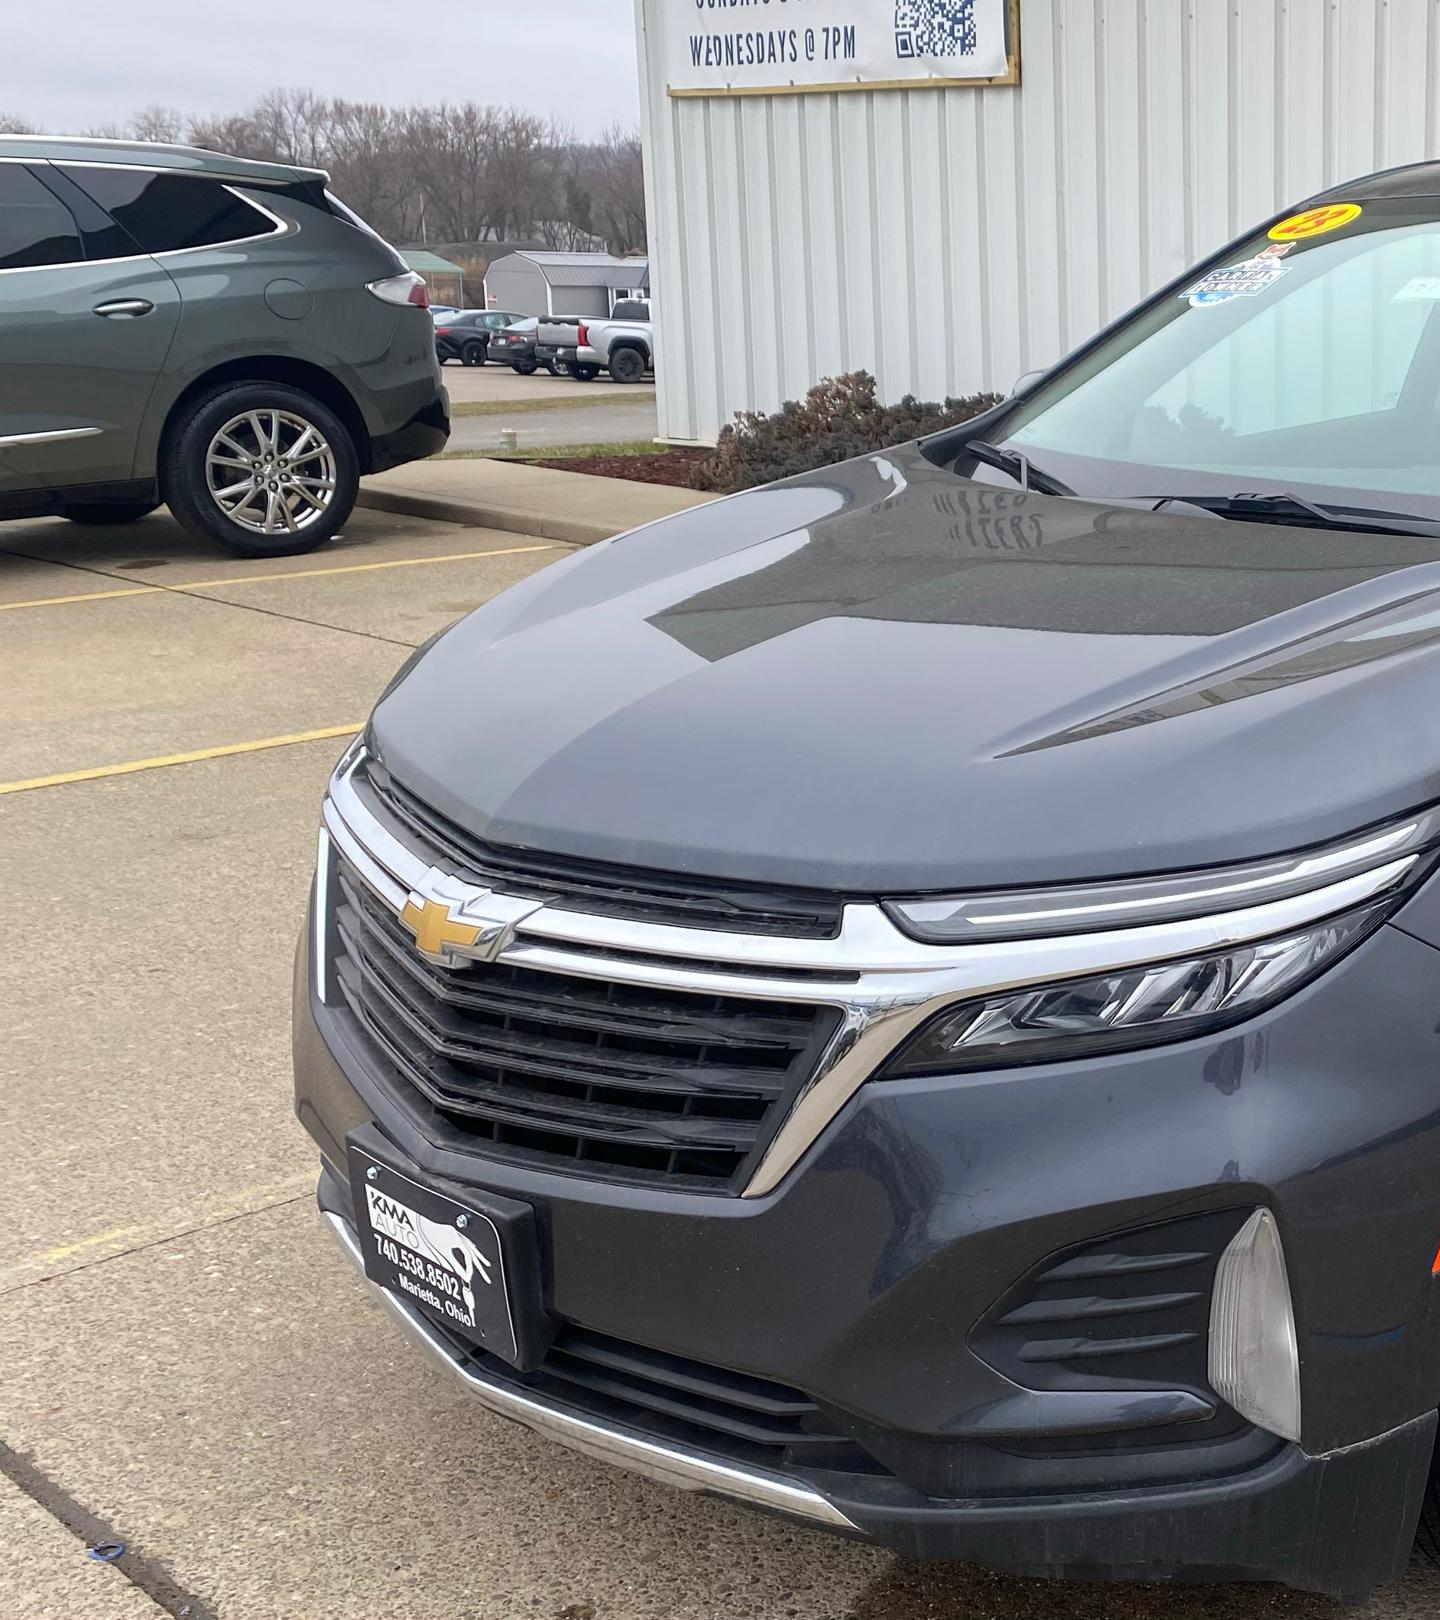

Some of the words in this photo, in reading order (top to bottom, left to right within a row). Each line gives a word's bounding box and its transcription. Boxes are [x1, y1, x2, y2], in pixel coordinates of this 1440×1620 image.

[689, 29, 798, 67] WEDNESDAYS
[804, 28, 815, 61] @
[822, 25, 855, 60] 7PM
[1276, 209, 1348, 234] 23
[370, 1190, 414, 1231] KMA
[375, 1214, 420, 1249] AUTO
[373, 1232, 461, 1300] 740.538.8502
[398, 1272, 445, 1314] Marietta,
[445, 1300, 472, 1327] Ohio
